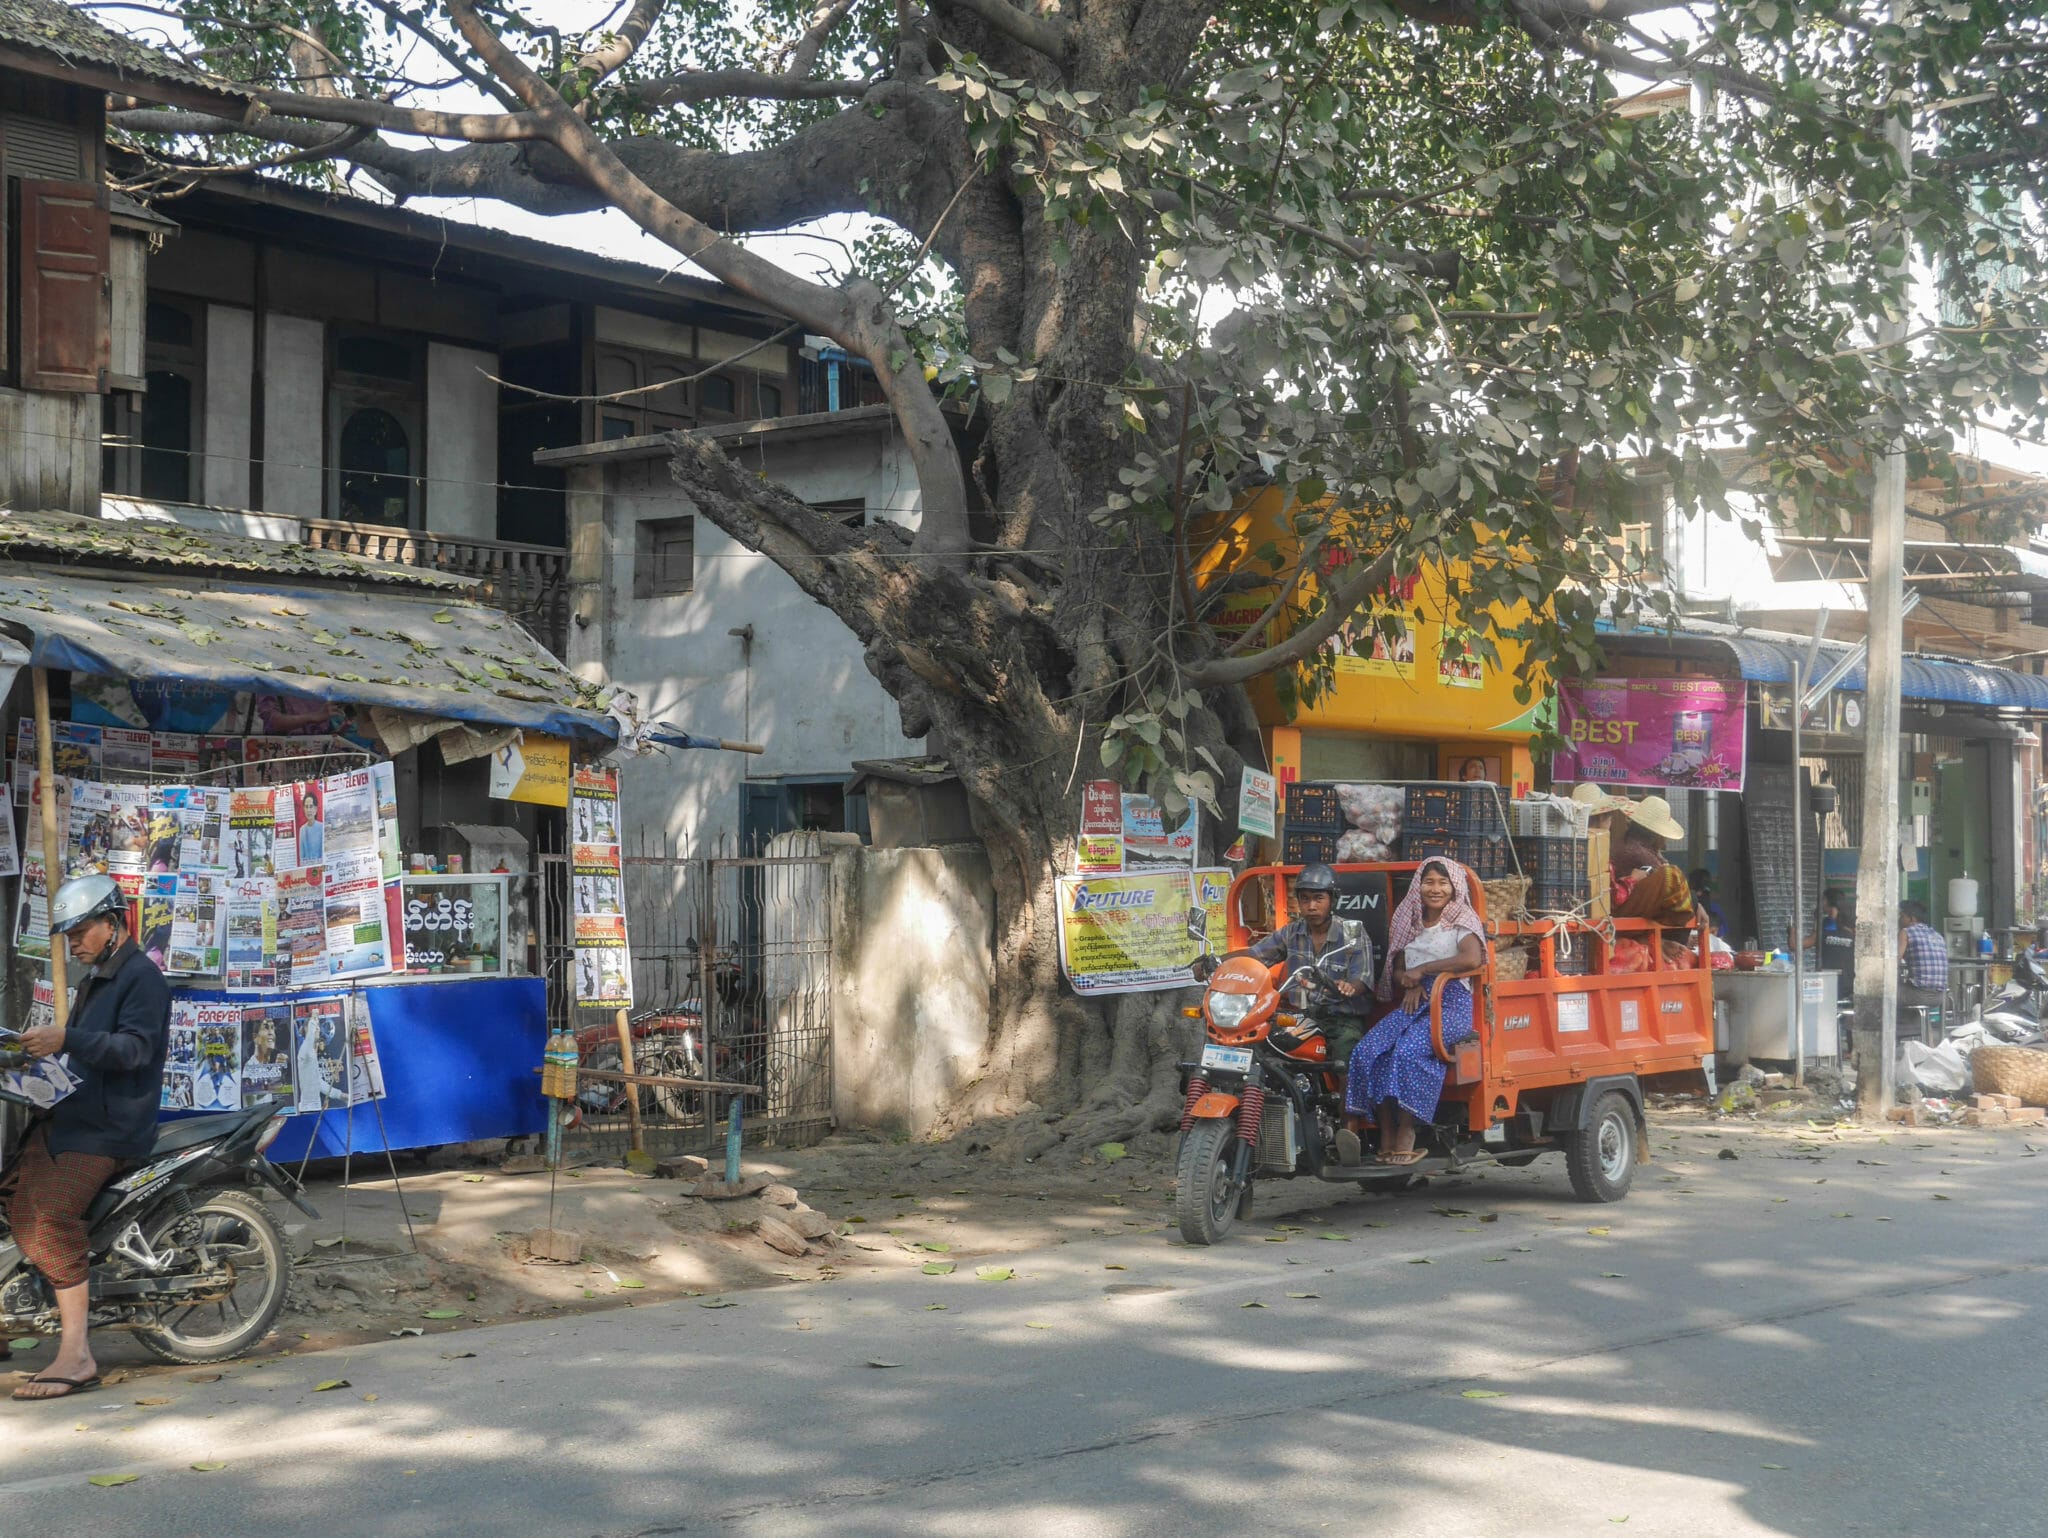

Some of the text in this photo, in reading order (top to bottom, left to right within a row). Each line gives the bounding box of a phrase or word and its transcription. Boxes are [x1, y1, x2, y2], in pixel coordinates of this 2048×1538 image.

[1673, 682, 1700, 692] BEST
[1571, 719, 1639, 744] BEST
[1676, 729, 1707, 742] BEST
[1610, 768, 1628, 779] MIX
[1086, 889, 1155, 908] FUTURE
[1217, 973, 1255, 983] LIFAN
[1661, 1001, 1683, 1013] LIFAN
[198, 1010, 241, 1023] FOREVER
[1504, 1013, 1530, 1030] LIFAN
[137, 1178, 170, 1202] KENBO
